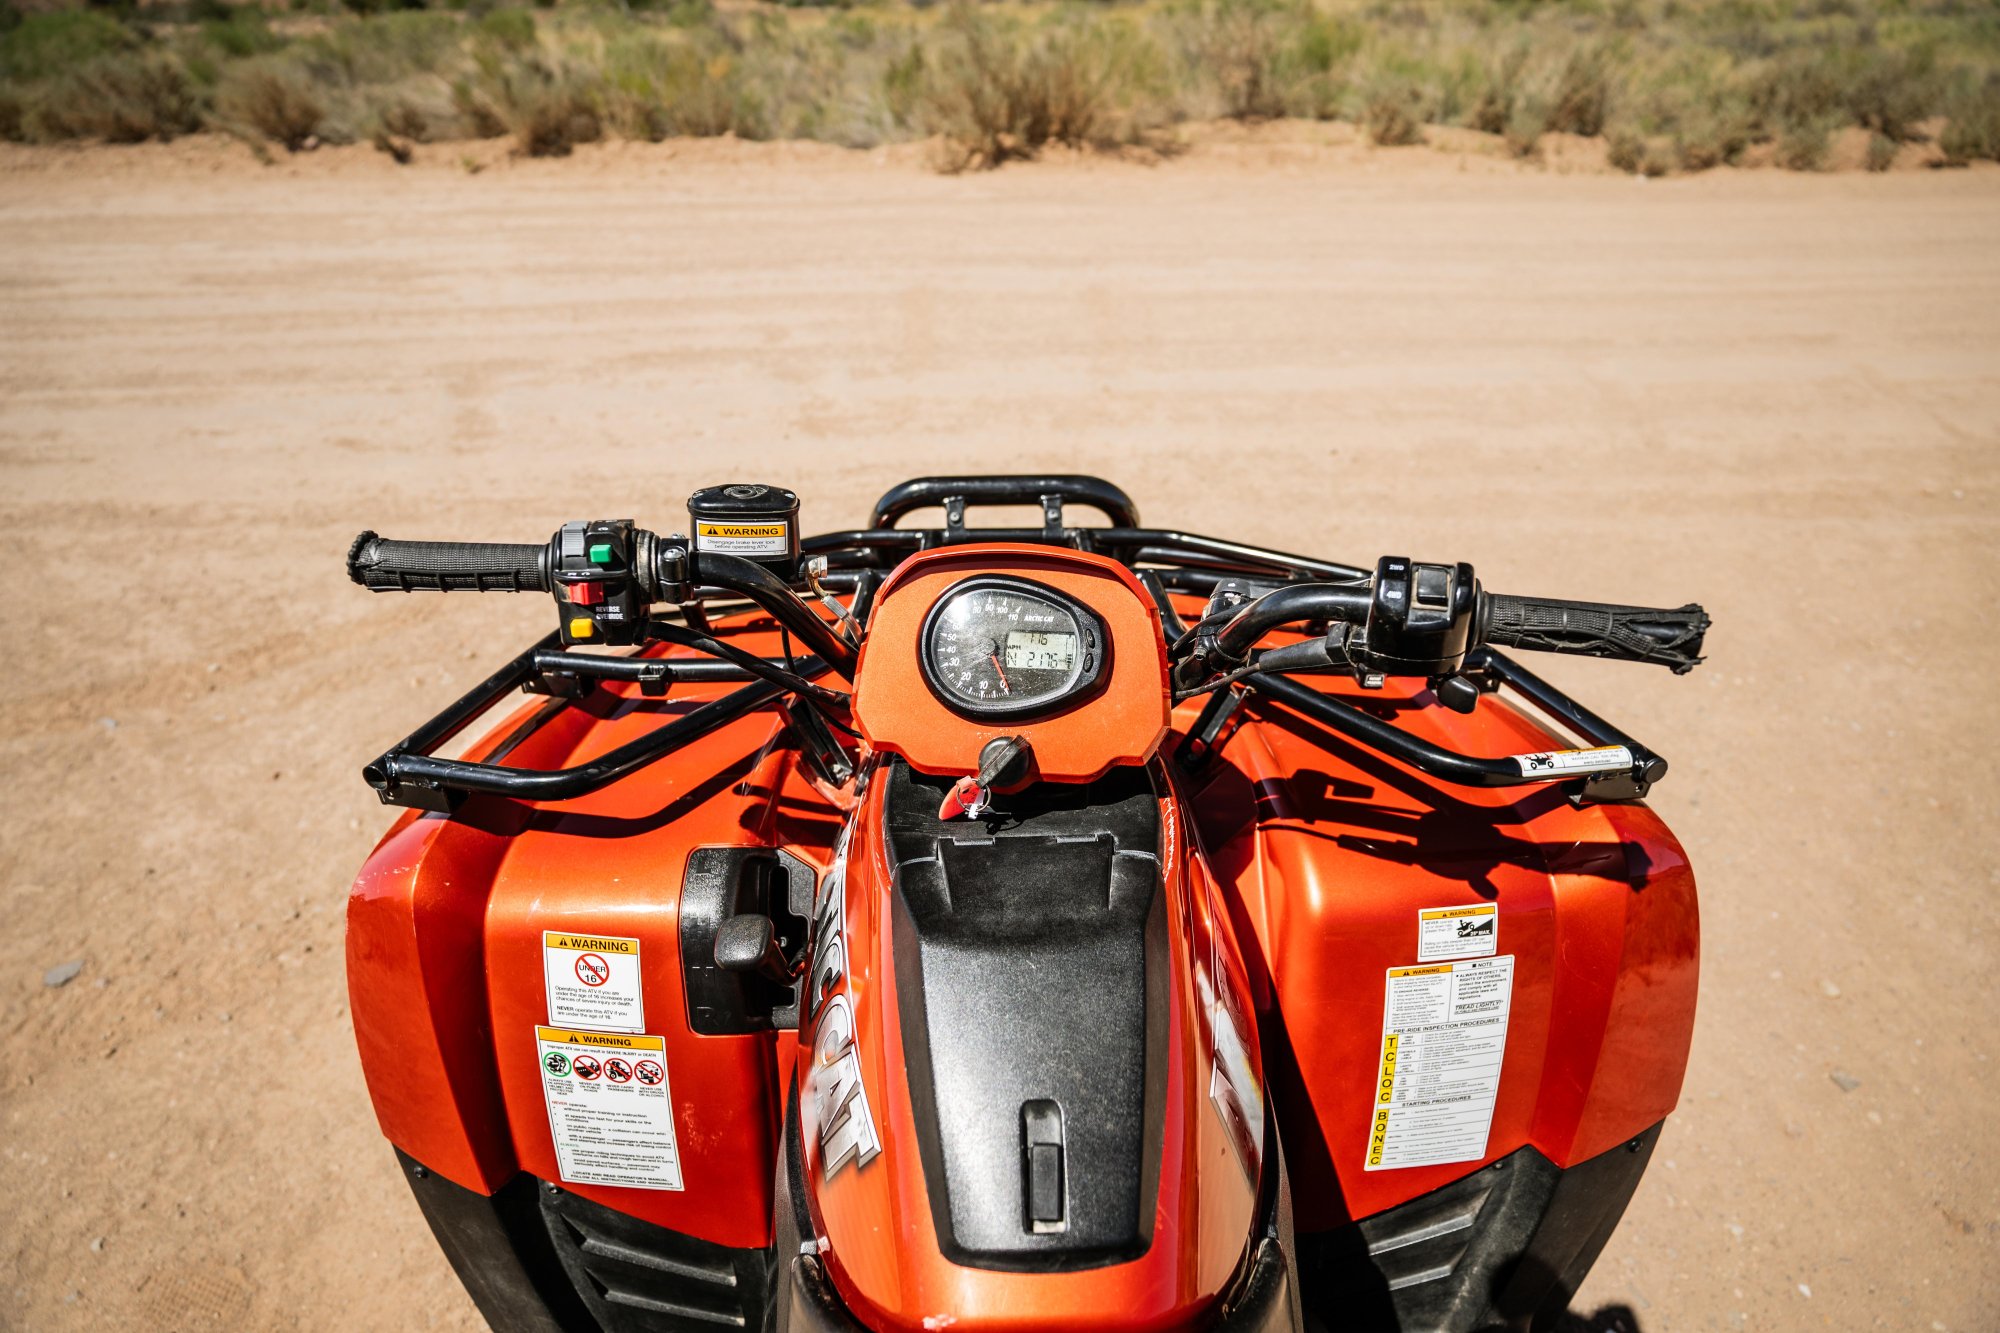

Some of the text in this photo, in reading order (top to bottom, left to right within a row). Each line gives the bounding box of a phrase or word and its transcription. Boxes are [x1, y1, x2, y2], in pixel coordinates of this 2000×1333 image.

[949, 658, 960, 666] 30
[961, 672, 971, 680] 20
[979, 680, 988, 689] 10
[571, 938, 629, 952] WARNING
[579, 964, 606, 973] UNDER
[585, 974, 597, 983] 16
[1423, 1023, 1458, 1031] INSPECTION
[1460, 1018, 1500, 1027] PROCEDURES
[583, 1035, 632, 1047] WARNING
[811, 995, 882, 1183] CAT
